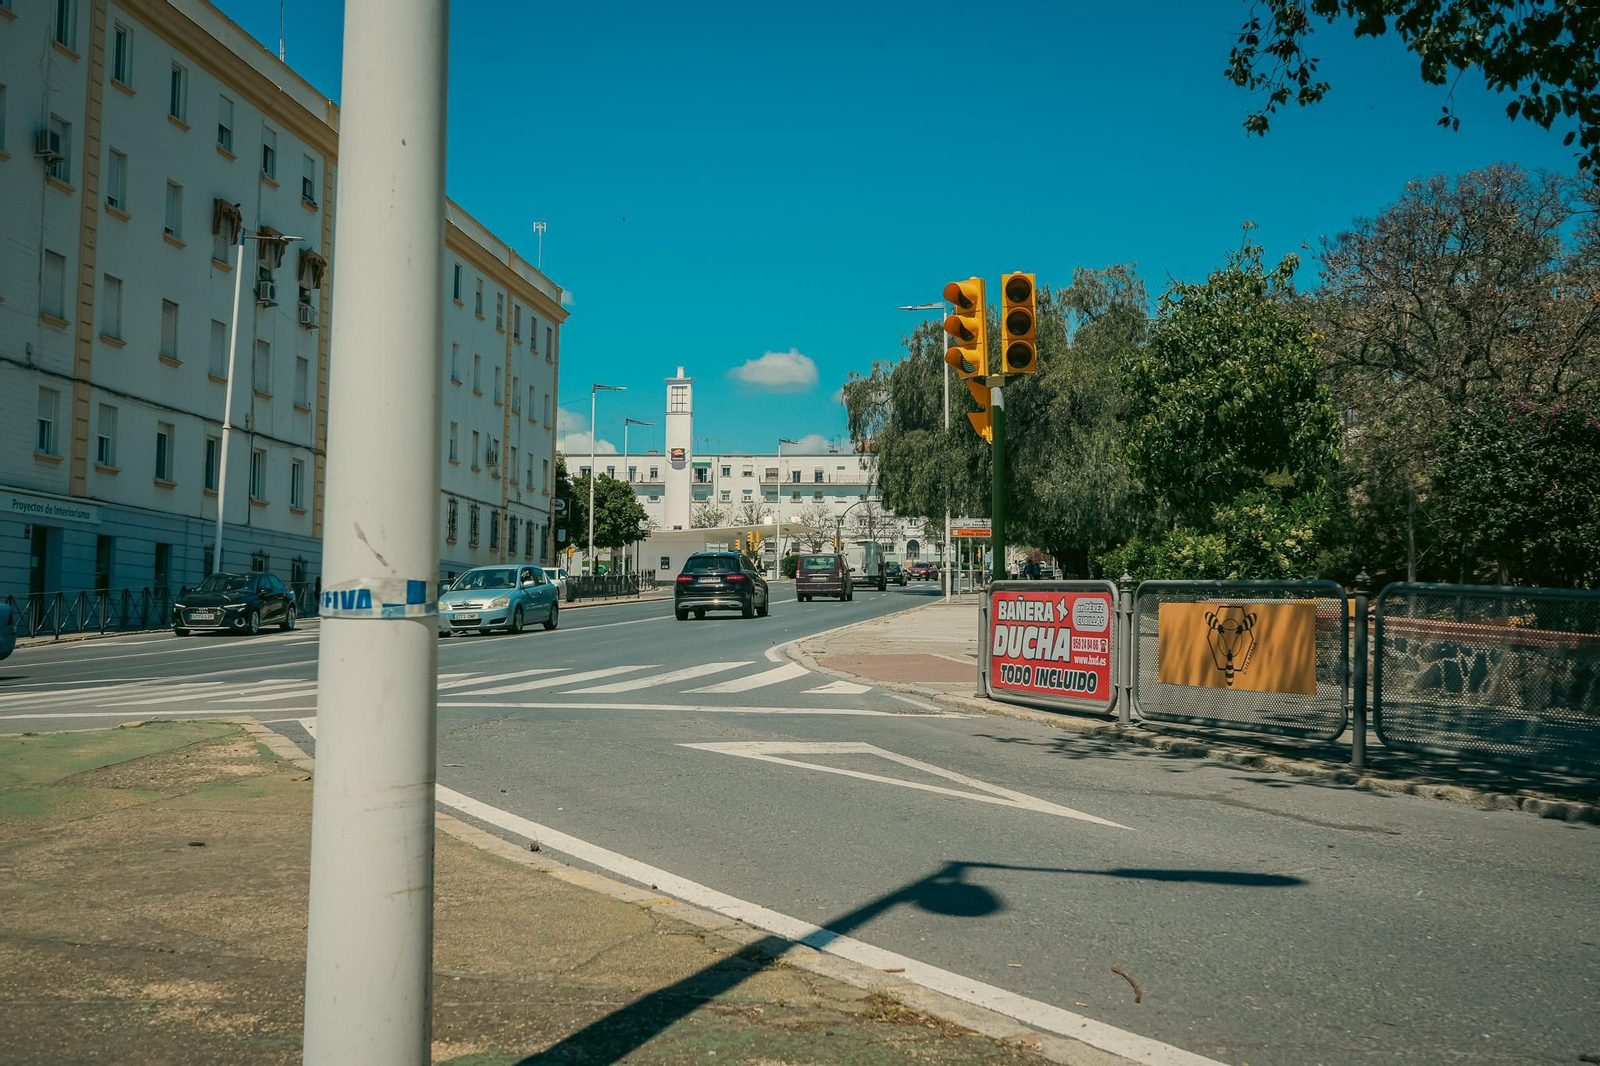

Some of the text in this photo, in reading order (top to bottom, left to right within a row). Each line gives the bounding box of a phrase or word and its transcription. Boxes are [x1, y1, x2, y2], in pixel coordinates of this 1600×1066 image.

[12, 498, 91, 519] Proyectos de Interiorismo
[998, 594, 1055, 622] BAÑERA
[1076, 614, 1104, 626] CUBILLAS
[1077, 601, 1103, 613] en PÉREZ
[992, 623, 1071, 662] DUCHA
[1242, 642, 1258, 675] CULMINA
[1000, 663, 1098, 694] TODO INCLUIDO
